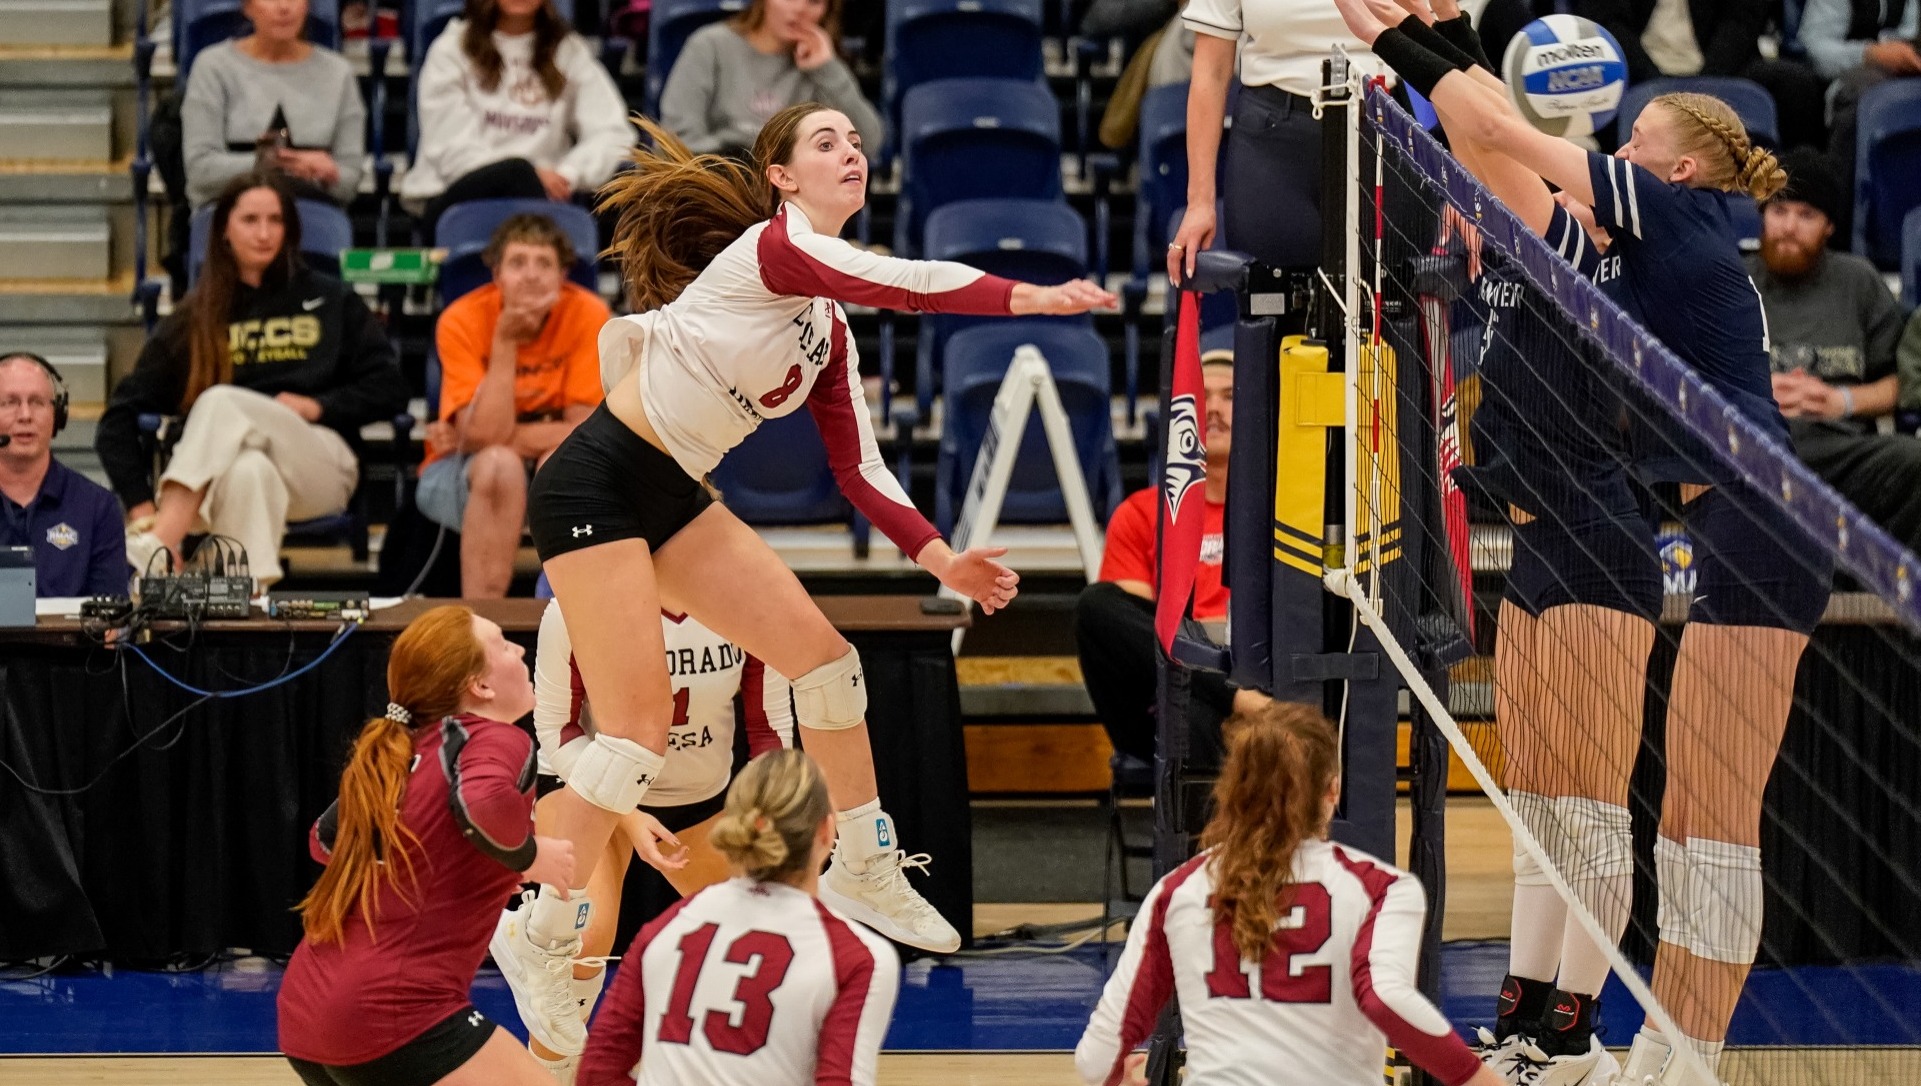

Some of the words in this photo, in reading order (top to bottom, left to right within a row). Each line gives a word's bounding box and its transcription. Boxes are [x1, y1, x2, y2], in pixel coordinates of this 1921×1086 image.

[1537, 43, 1605, 67] molten
[758, 362, 803, 409] 8
[667, 725, 714, 751] ESA
[1204, 881, 1333, 1004] 12
[657, 921, 796, 1057] 13
